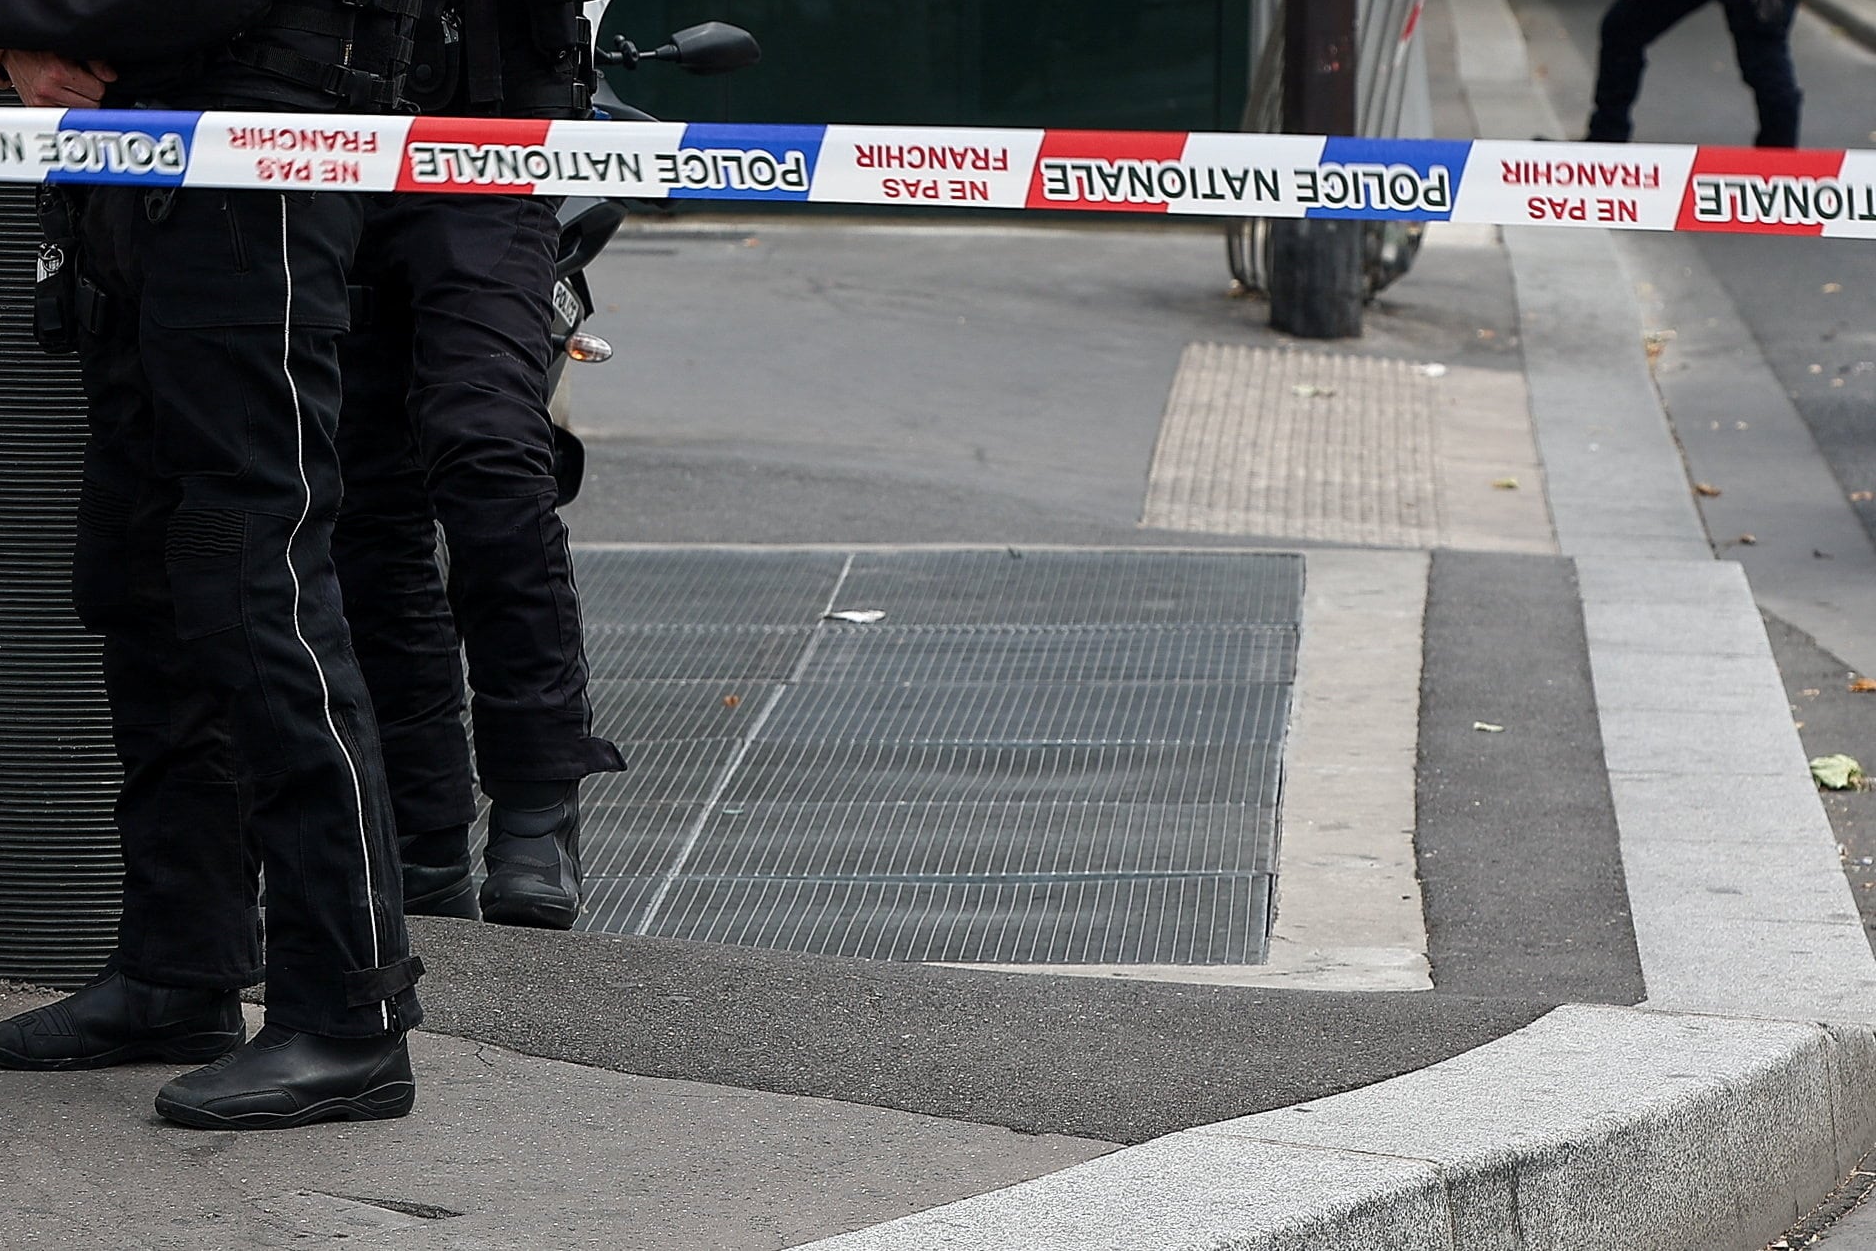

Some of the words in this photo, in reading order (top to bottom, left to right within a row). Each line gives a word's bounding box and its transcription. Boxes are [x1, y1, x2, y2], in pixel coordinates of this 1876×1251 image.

[37, 132, 184, 167] POLICE
[228, 127, 378, 153] FRANCHIR
[256, 158, 311, 181] PAS
[413, 147, 642, 182] NATIONALE
[655, 154, 805, 187] POLICE
[854, 144, 1008, 171] FRANCHIR
[322, 160, 360, 183] NE
[1043, 162, 1280, 202] NATIONALE
[1500, 159, 1660, 189] FRANCHIR
[882, 178, 938, 199] PAS
[949, 180, 988, 201] NE
[1294, 171, 1448, 207] POLICE
[1528, 197, 1586, 221] PAS
[1597, 199, 1637, 222] NE
[554, 286, 577, 323] POLICE
